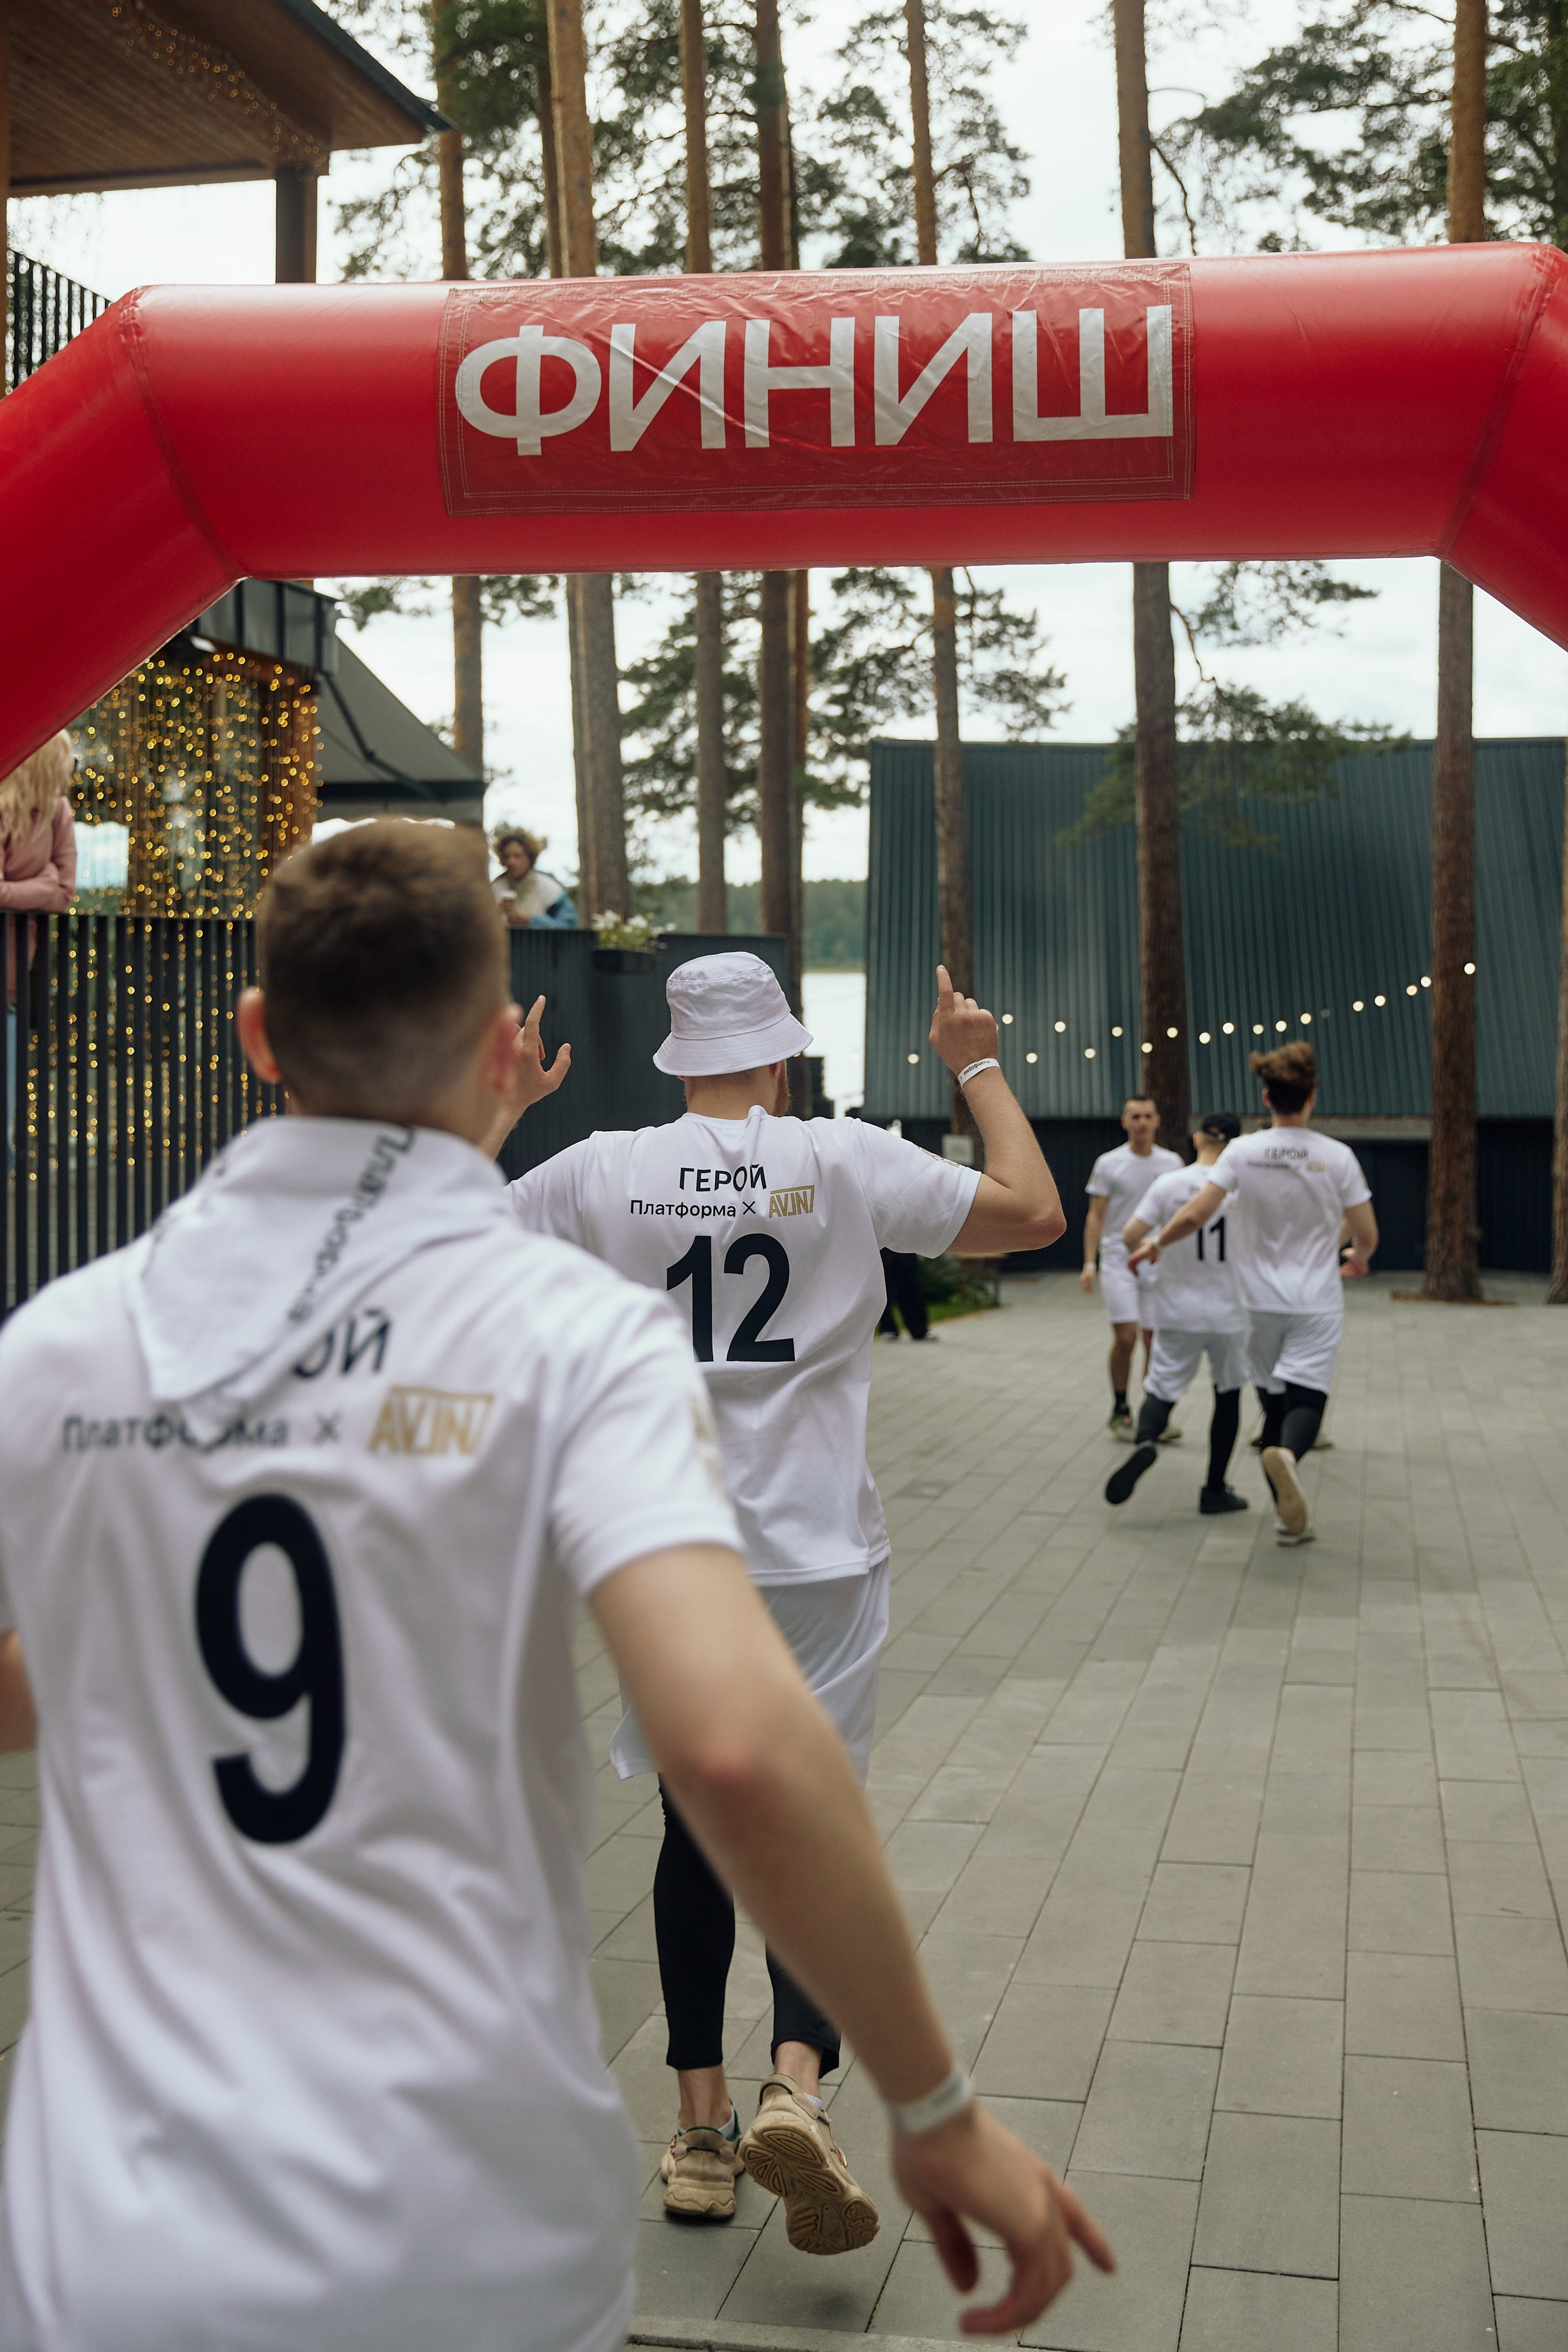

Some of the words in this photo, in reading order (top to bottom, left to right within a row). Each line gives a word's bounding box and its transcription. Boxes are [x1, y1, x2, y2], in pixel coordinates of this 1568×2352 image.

[455, 304, 1174, 456] ФИНИШ
[630, 1199, 736, 1219] Платформа
[679, 1164, 767, 1192] ГЕРОЙ
[666, 1232, 796, 1362] 12
[195, 1493, 345, 1845] 9
